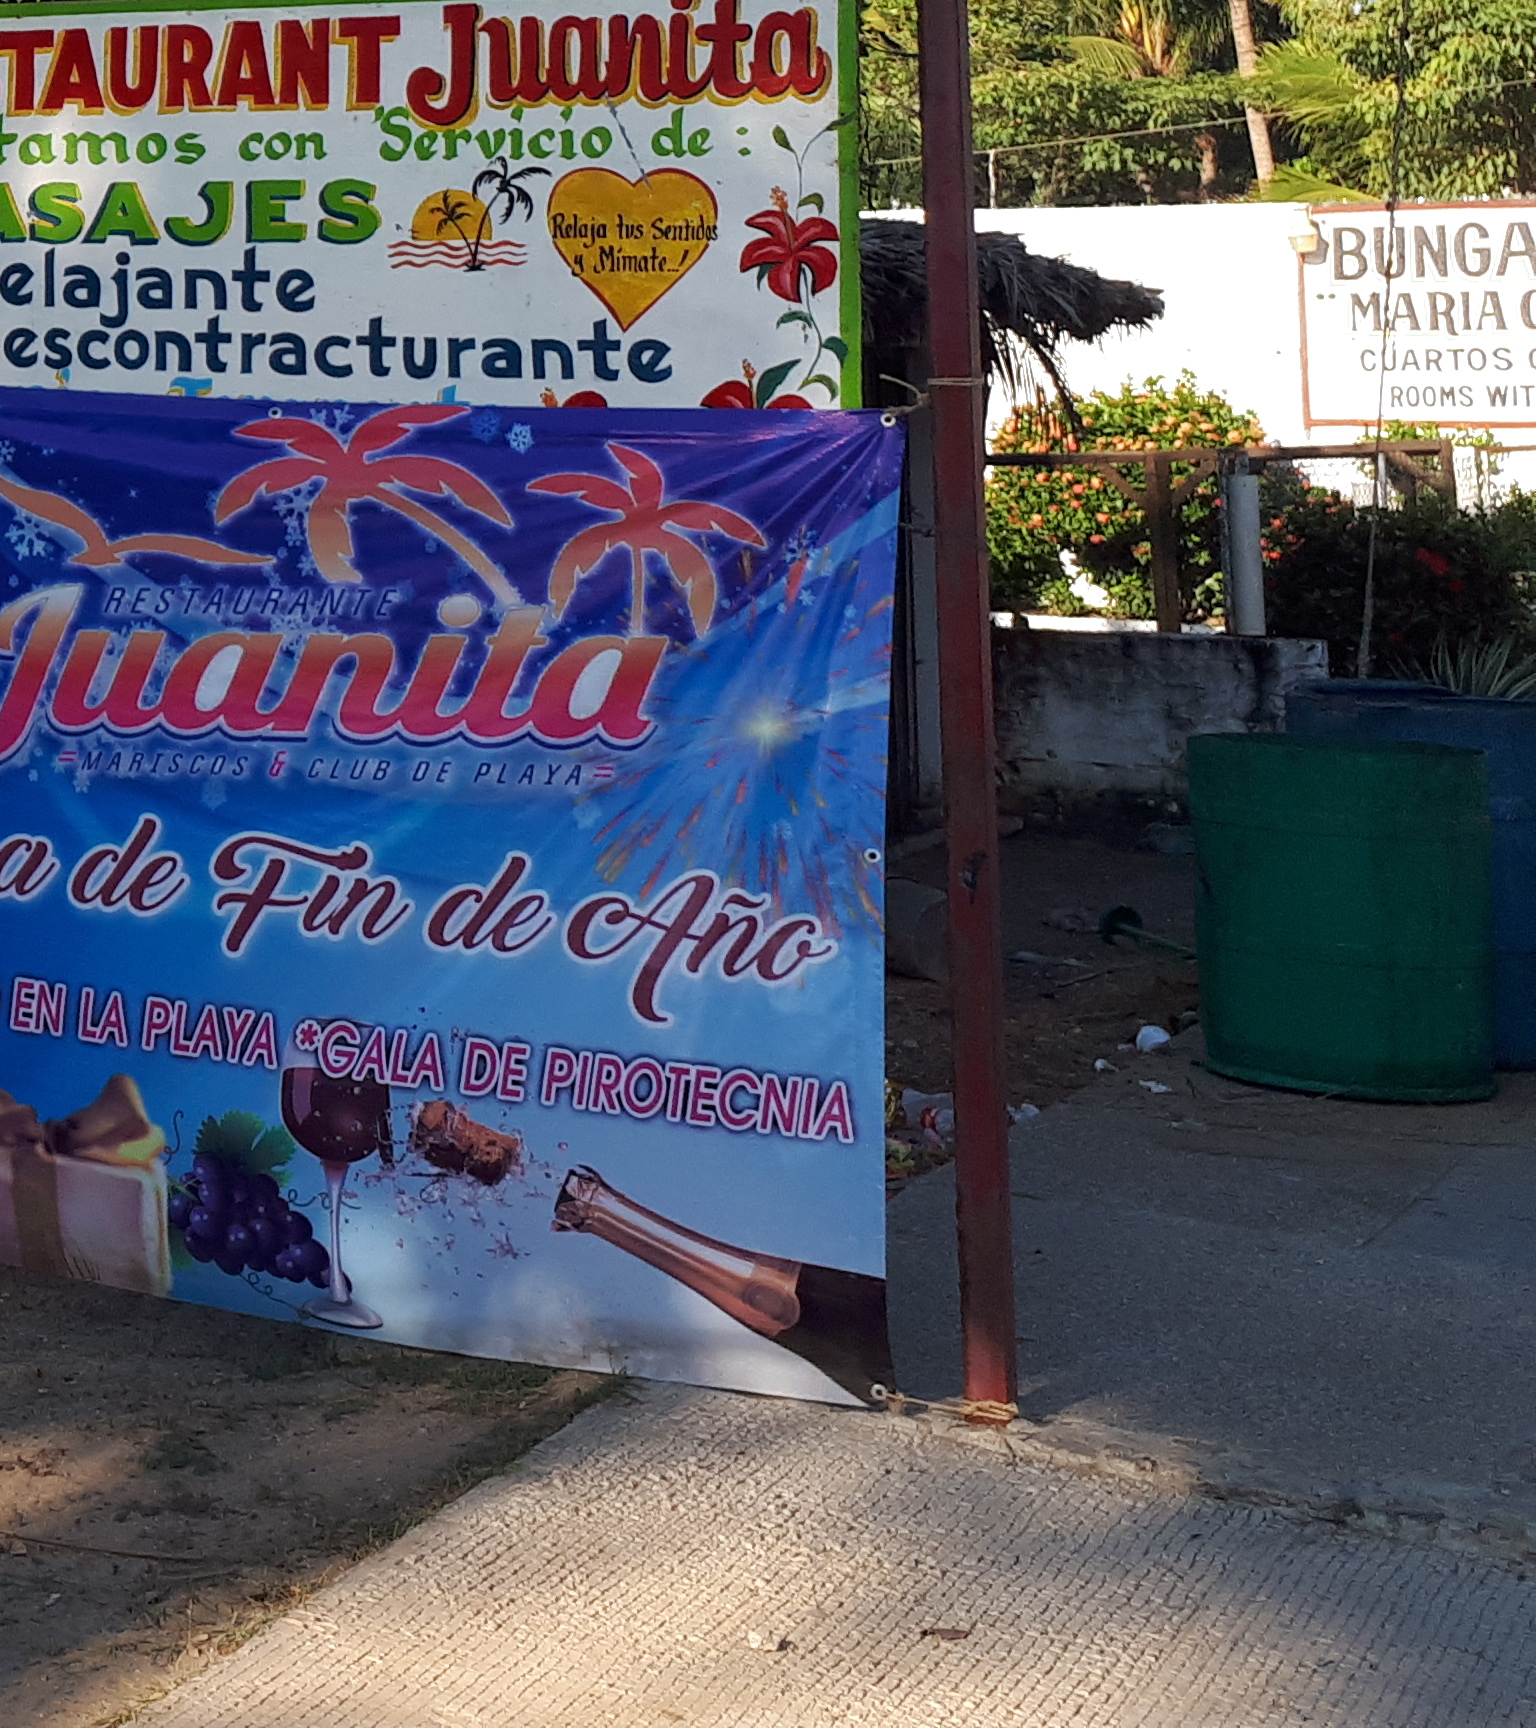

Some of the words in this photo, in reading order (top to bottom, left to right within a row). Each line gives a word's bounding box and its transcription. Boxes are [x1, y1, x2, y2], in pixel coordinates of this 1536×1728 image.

[238, 126, 328, 162] con
[373, 105, 613, 162] Servicio
[550, 212, 608, 249] Relaja
[616, 213, 644, 240] tus
[651, 215, 718, 241] Sentidos
[1332, 222, 1536, 280] BUNGA
[1350, 290, 1508, 336] MARIA
[1360, 347, 1514, 372] CUARTOS
[1390, 385, 1474, 407] ROOMS
[1486, 385, 1535, 407] WIT
[103, 586, 401, 617] RESTAURANTE
[79, 750, 249, 776] MARISCOS
[268, 750, 287, 777] &
[307, 756, 388, 781] CLUB
[412, 760, 451, 784] DE
[474, 761, 582, 787] PLAYA
[69, 816, 187, 912] de
[213, 833, 409, 953] Fin
[427, 854, 552, 953] de
[566, 874, 832, 1023] Año
[13, 978, 66, 1036] EN
[79, 987, 126, 1047] LA
[142, 997, 278, 1069] PLAYA
[460, 1038, 529, 1100] DE
[541, 1047, 854, 1143] PIROTECNIA
